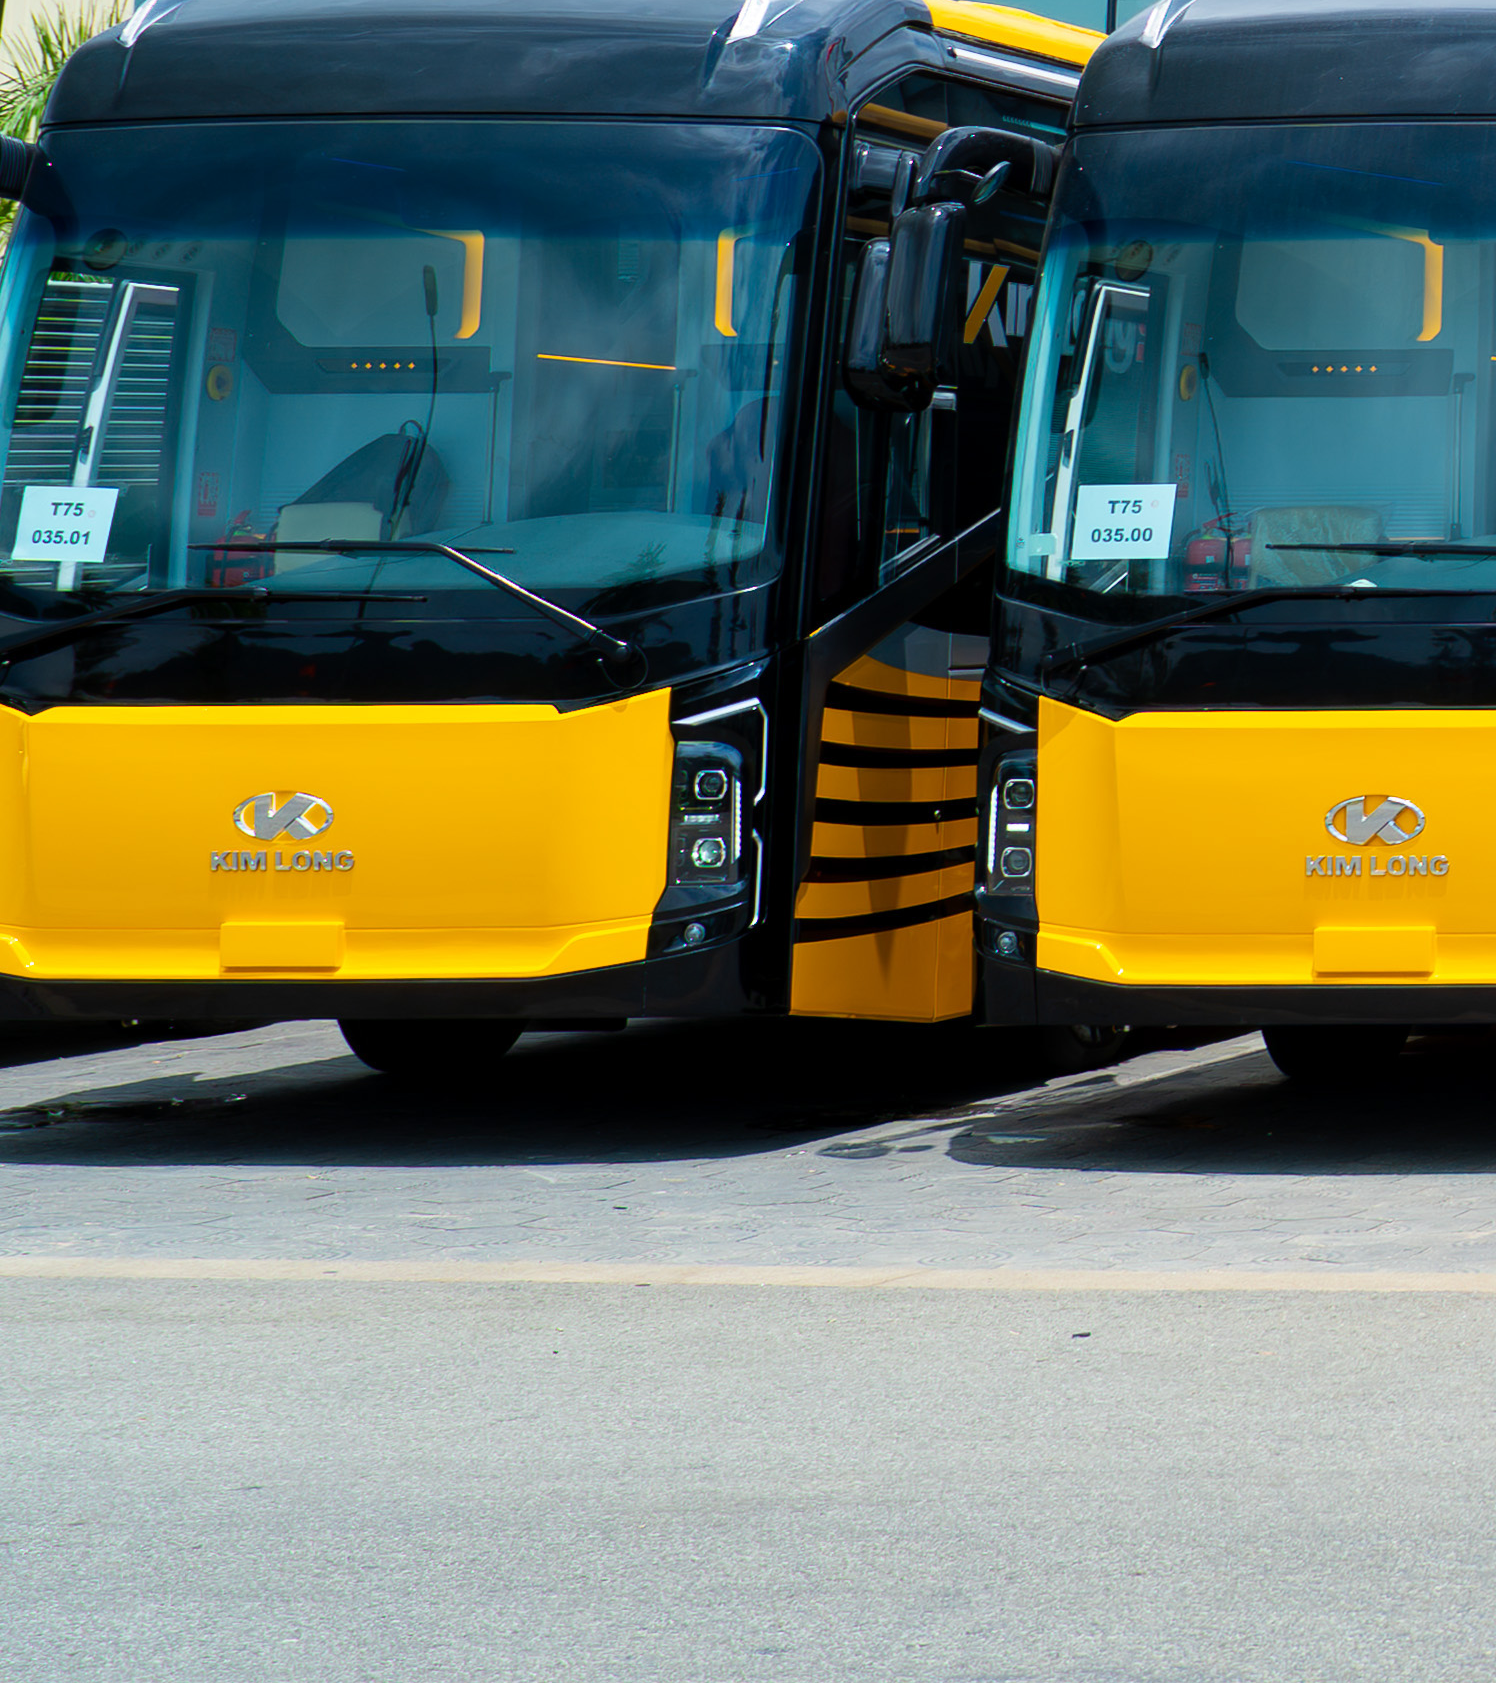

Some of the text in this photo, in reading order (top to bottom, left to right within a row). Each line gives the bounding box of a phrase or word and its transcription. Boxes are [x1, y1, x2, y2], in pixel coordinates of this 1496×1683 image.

[50, 501, 85, 517] T75
[1107, 499, 1143, 515] T75
[31, 529, 91, 545] 035.01
[1091, 527, 1153, 543] 035.00
[210, 849, 356, 872] KIM LONG
[1304, 854, 1450, 877] KIM LONG
